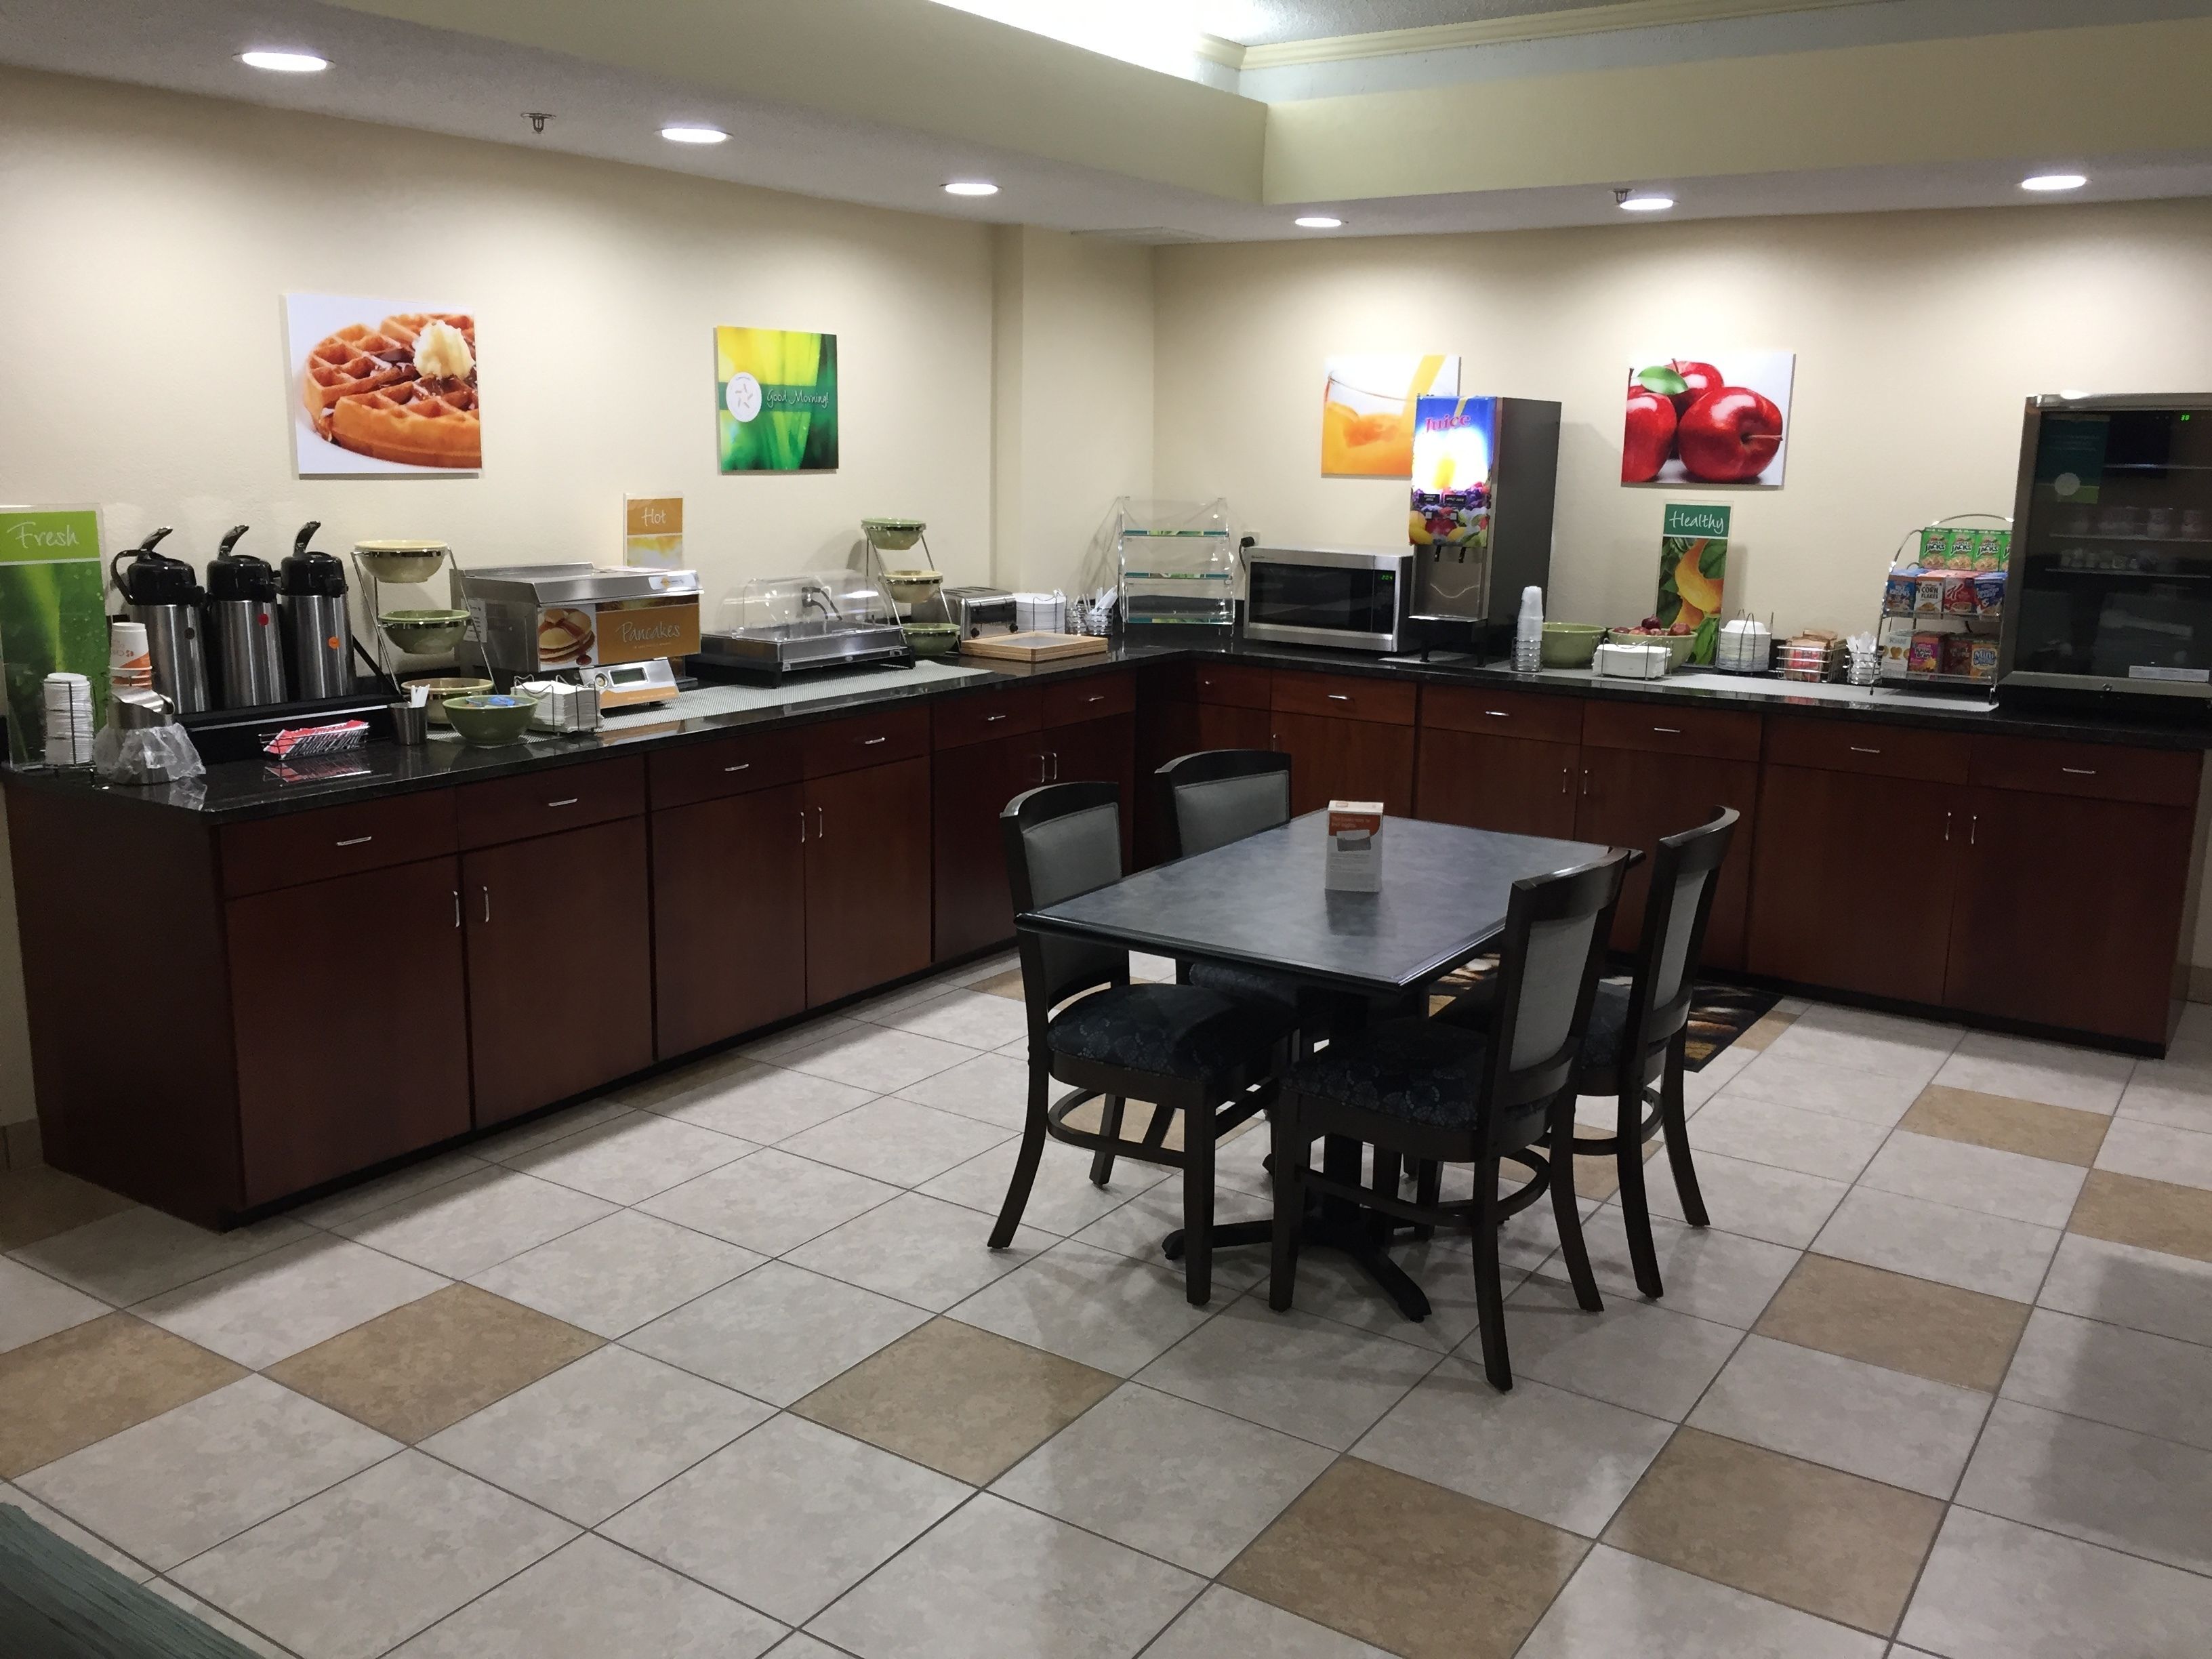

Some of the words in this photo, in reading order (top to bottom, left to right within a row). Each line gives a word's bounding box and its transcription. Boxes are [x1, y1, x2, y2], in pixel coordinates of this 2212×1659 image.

[767, 389, 787, 408] Good
[788, 390, 829, 409] Morning!
[1425, 413, 1471, 433] Juice
[641, 507, 666, 527] Hot
[1669, 510, 1724, 534] Healthy
[7, 521, 80, 549] Fresh
[615, 621, 680, 642] Pancakes
